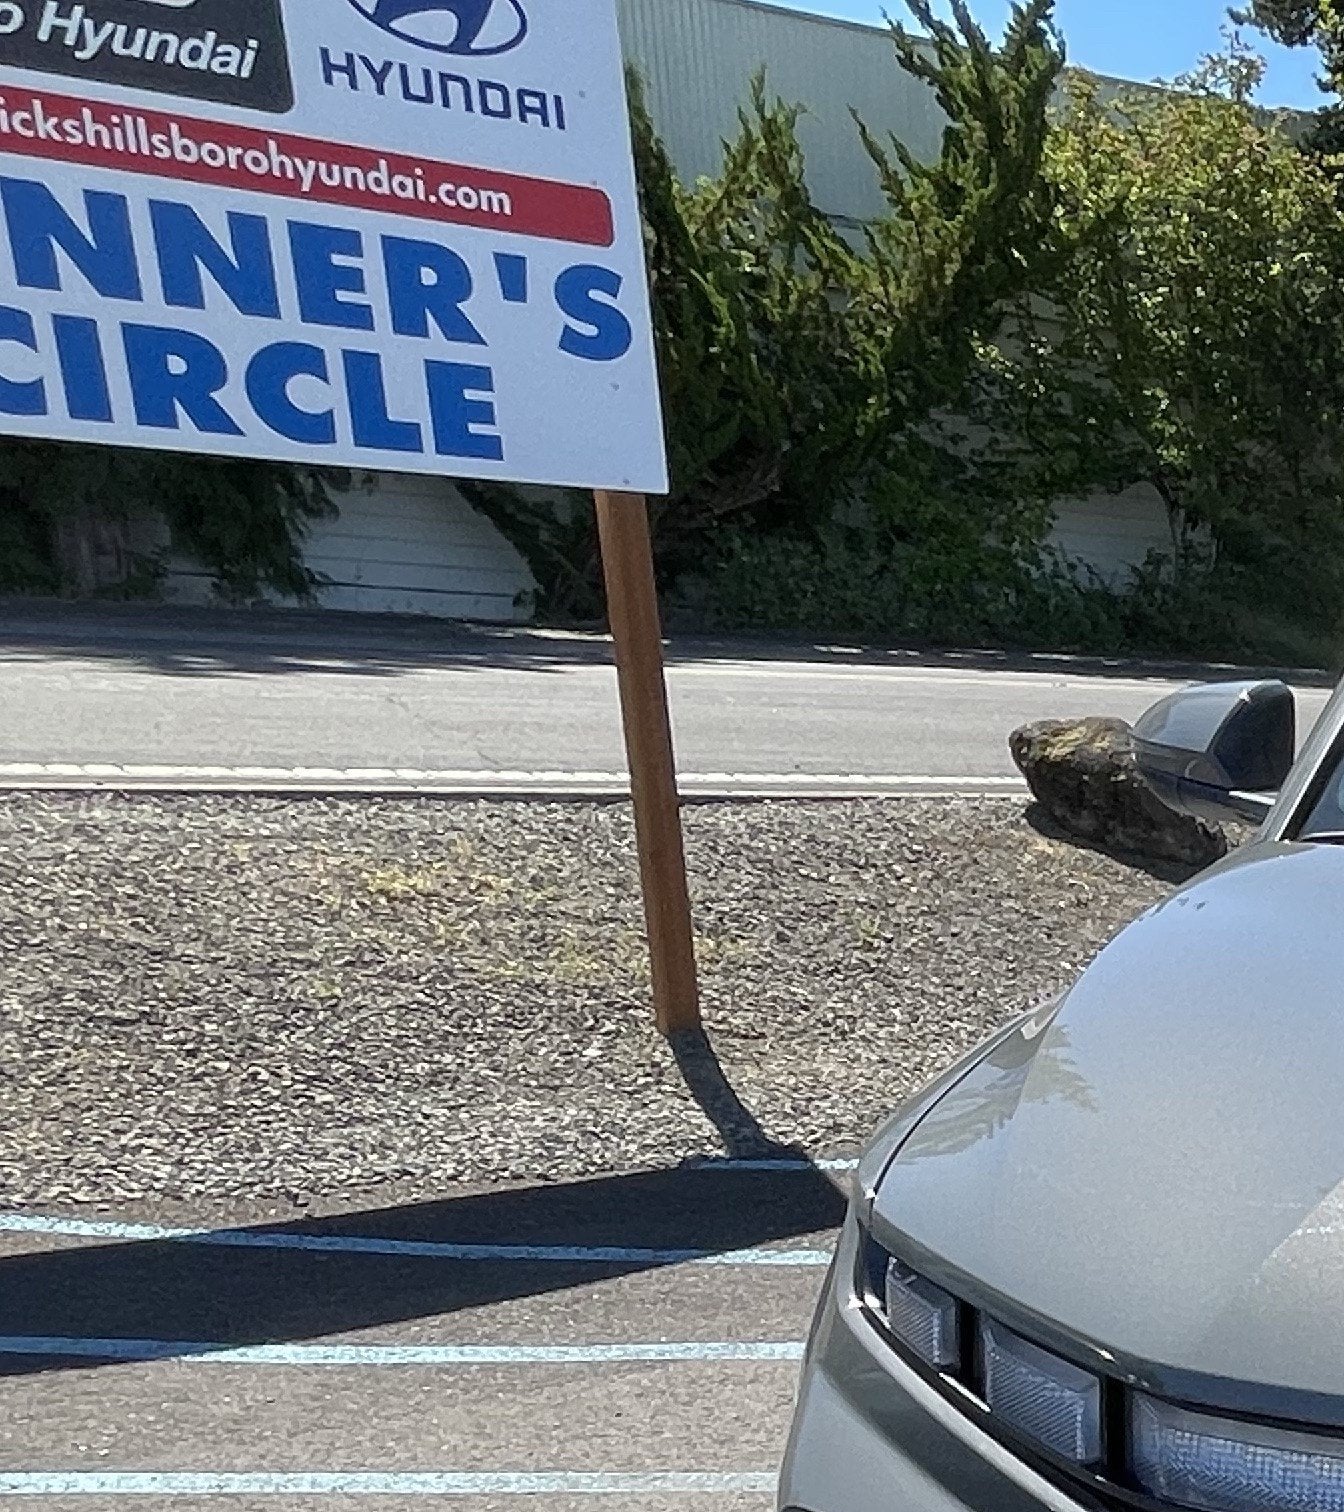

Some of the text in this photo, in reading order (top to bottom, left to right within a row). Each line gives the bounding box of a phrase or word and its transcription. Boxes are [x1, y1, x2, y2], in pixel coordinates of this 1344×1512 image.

[36, 1, 259, 78] Hyundai
[319, 47, 566, 130] HYUNDAI
[0, 96, 512, 215] ickshillsborohyundai.com
[0, 176, 632, 361] NNER'S
